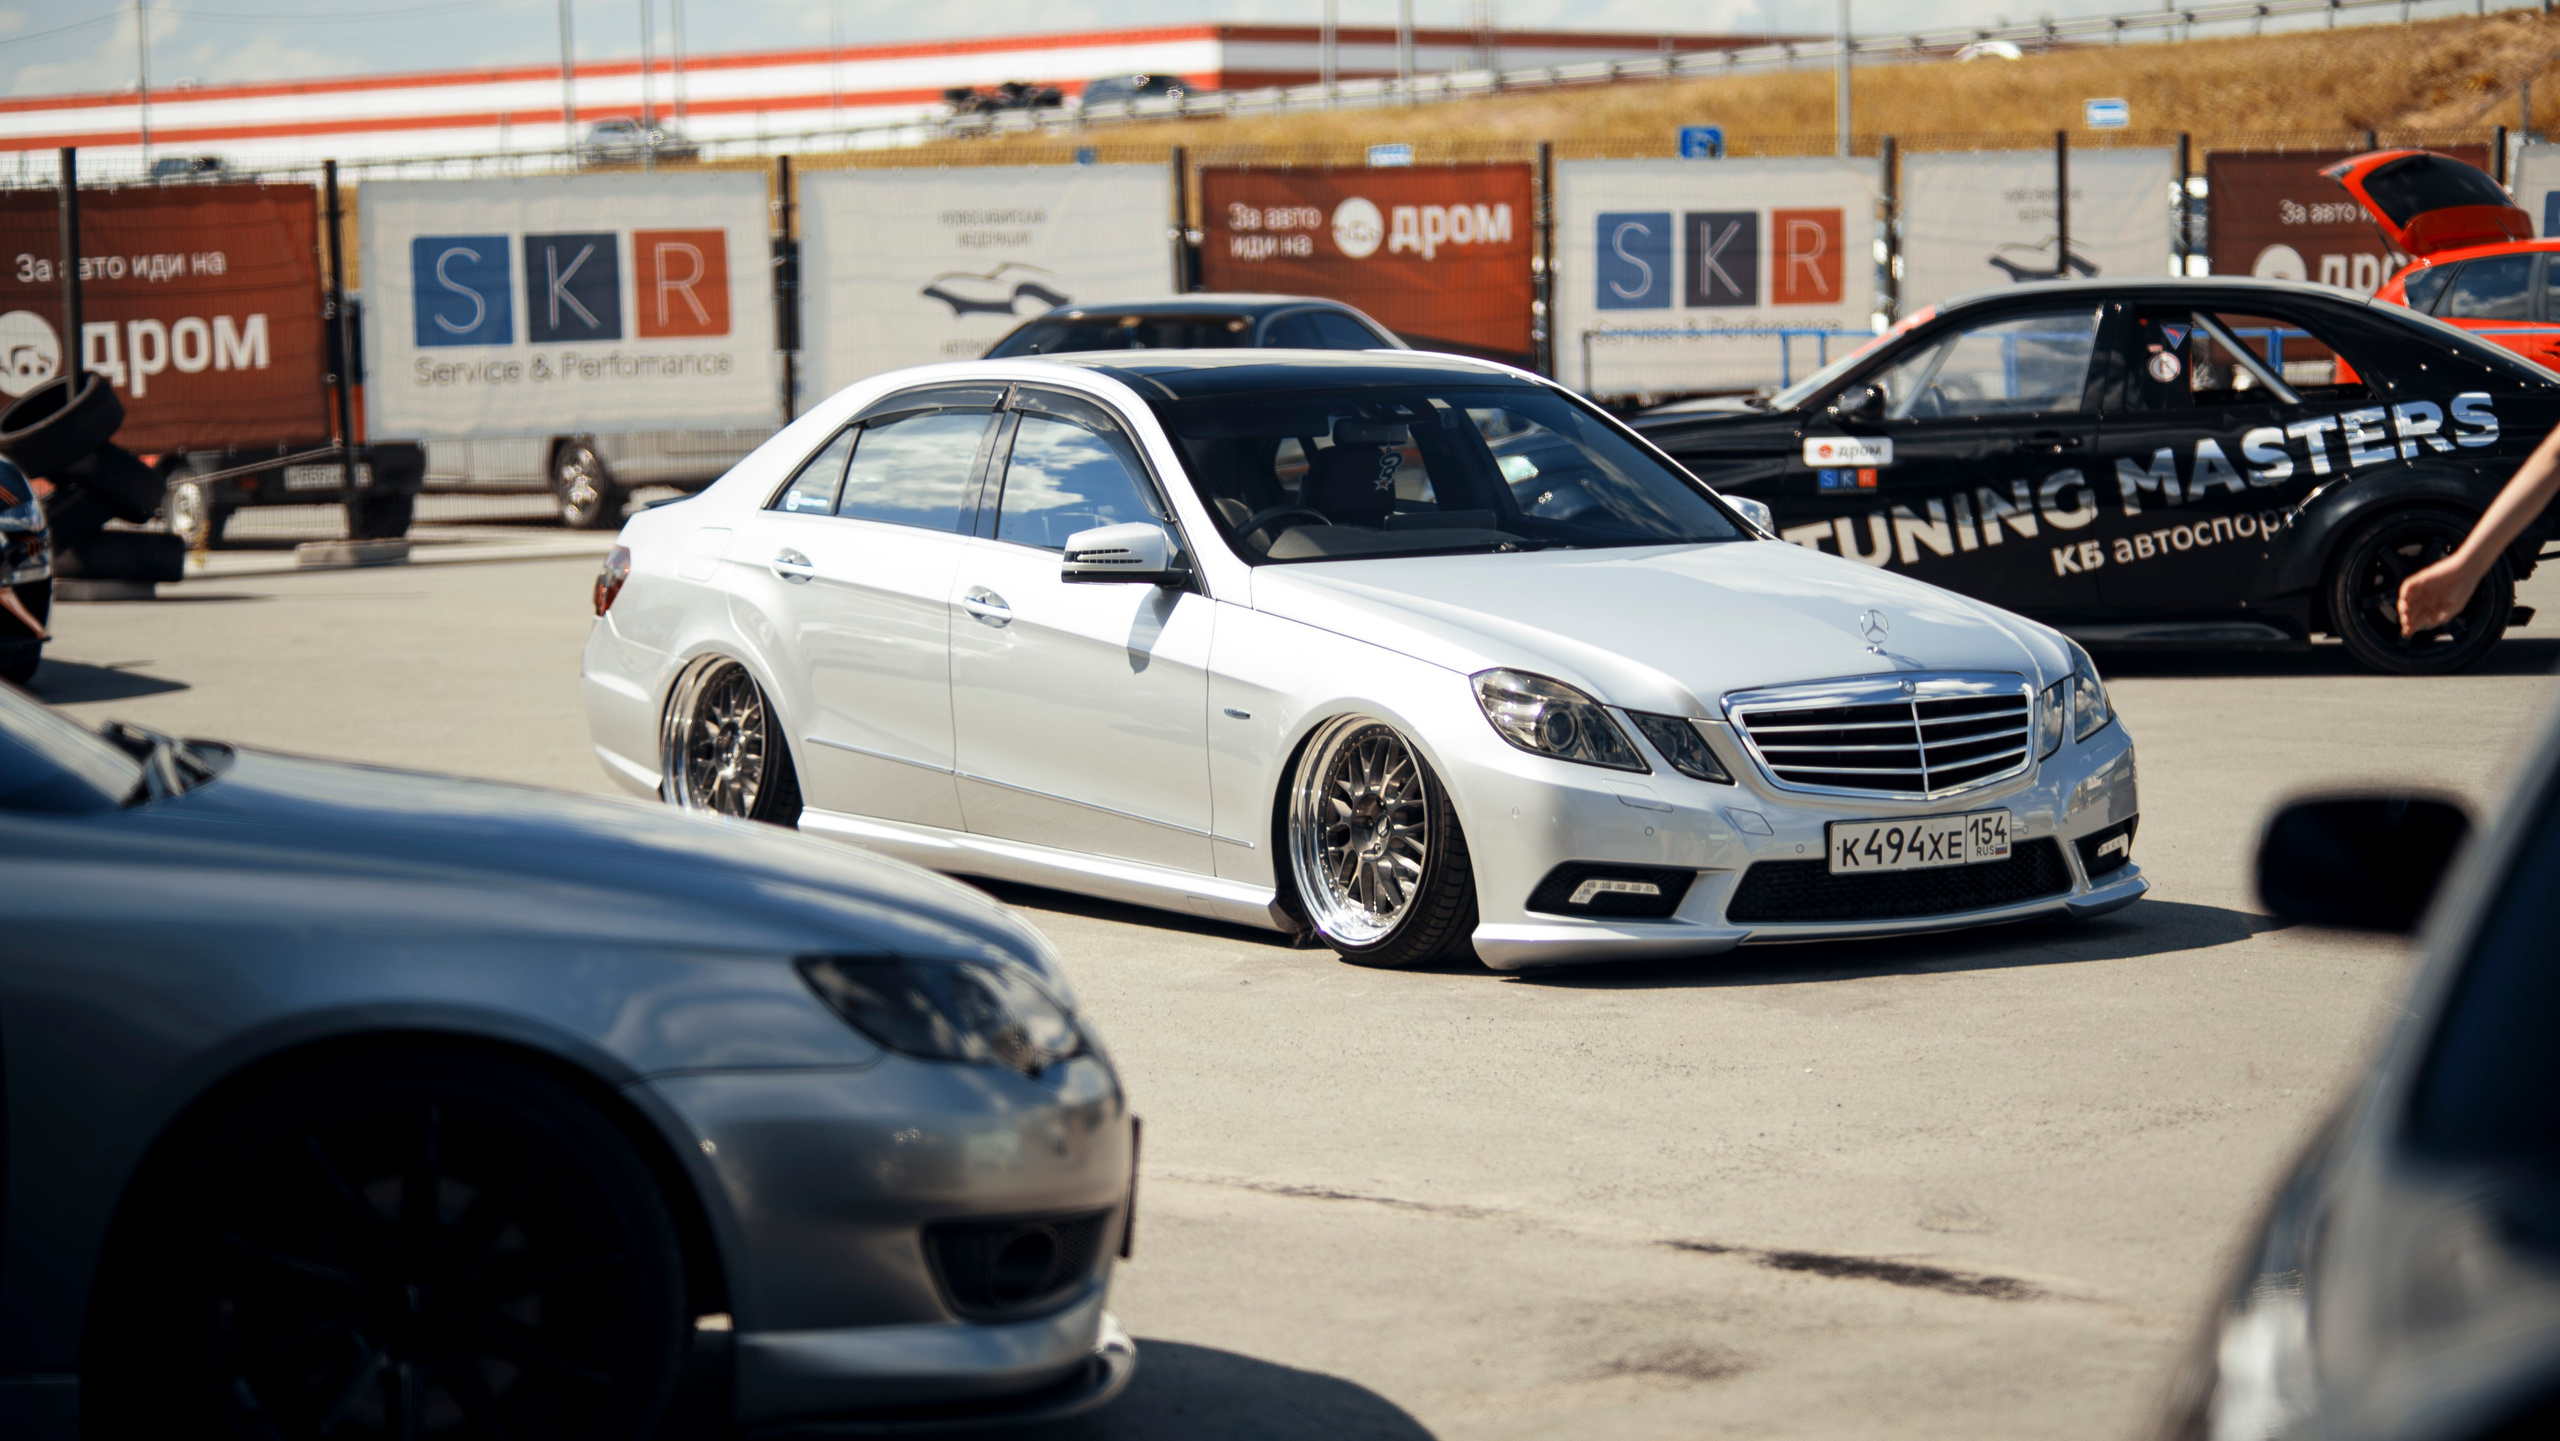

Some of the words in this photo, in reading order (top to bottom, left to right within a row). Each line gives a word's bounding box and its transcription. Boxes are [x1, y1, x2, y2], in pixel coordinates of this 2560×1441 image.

[1229, 203, 1262, 230] За
[1263, 207, 1321, 229] авто
[2279, 199, 2307, 225] За
[2310, 203, 2357, 223] авто
[1230, 235, 1277, 261] иди
[1280, 234, 1313, 257] на
[1388, 203, 1512, 260] дром
[15, 253, 53, 282] За
[59, 256, 127, 280] вто
[131, 254, 186, 281] иди
[191, 251, 226, 276] на
[2320, 253, 2418, 296] дро
[82, 313, 269, 398] дром
[414, 355, 524, 386] Service
[530, 353, 556, 382] &
[1839, 444, 1882, 460] дром
[1780, 467, 2098, 567] TUNING
[2115, 391, 2501, 518] MASTERS
[2052, 540, 2105, 577] КБ
[1842, 825, 1963, 867] К494ХЕ
[1969, 816, 2007, 846] 154
[1976, 845, 1995, 857] RUS
